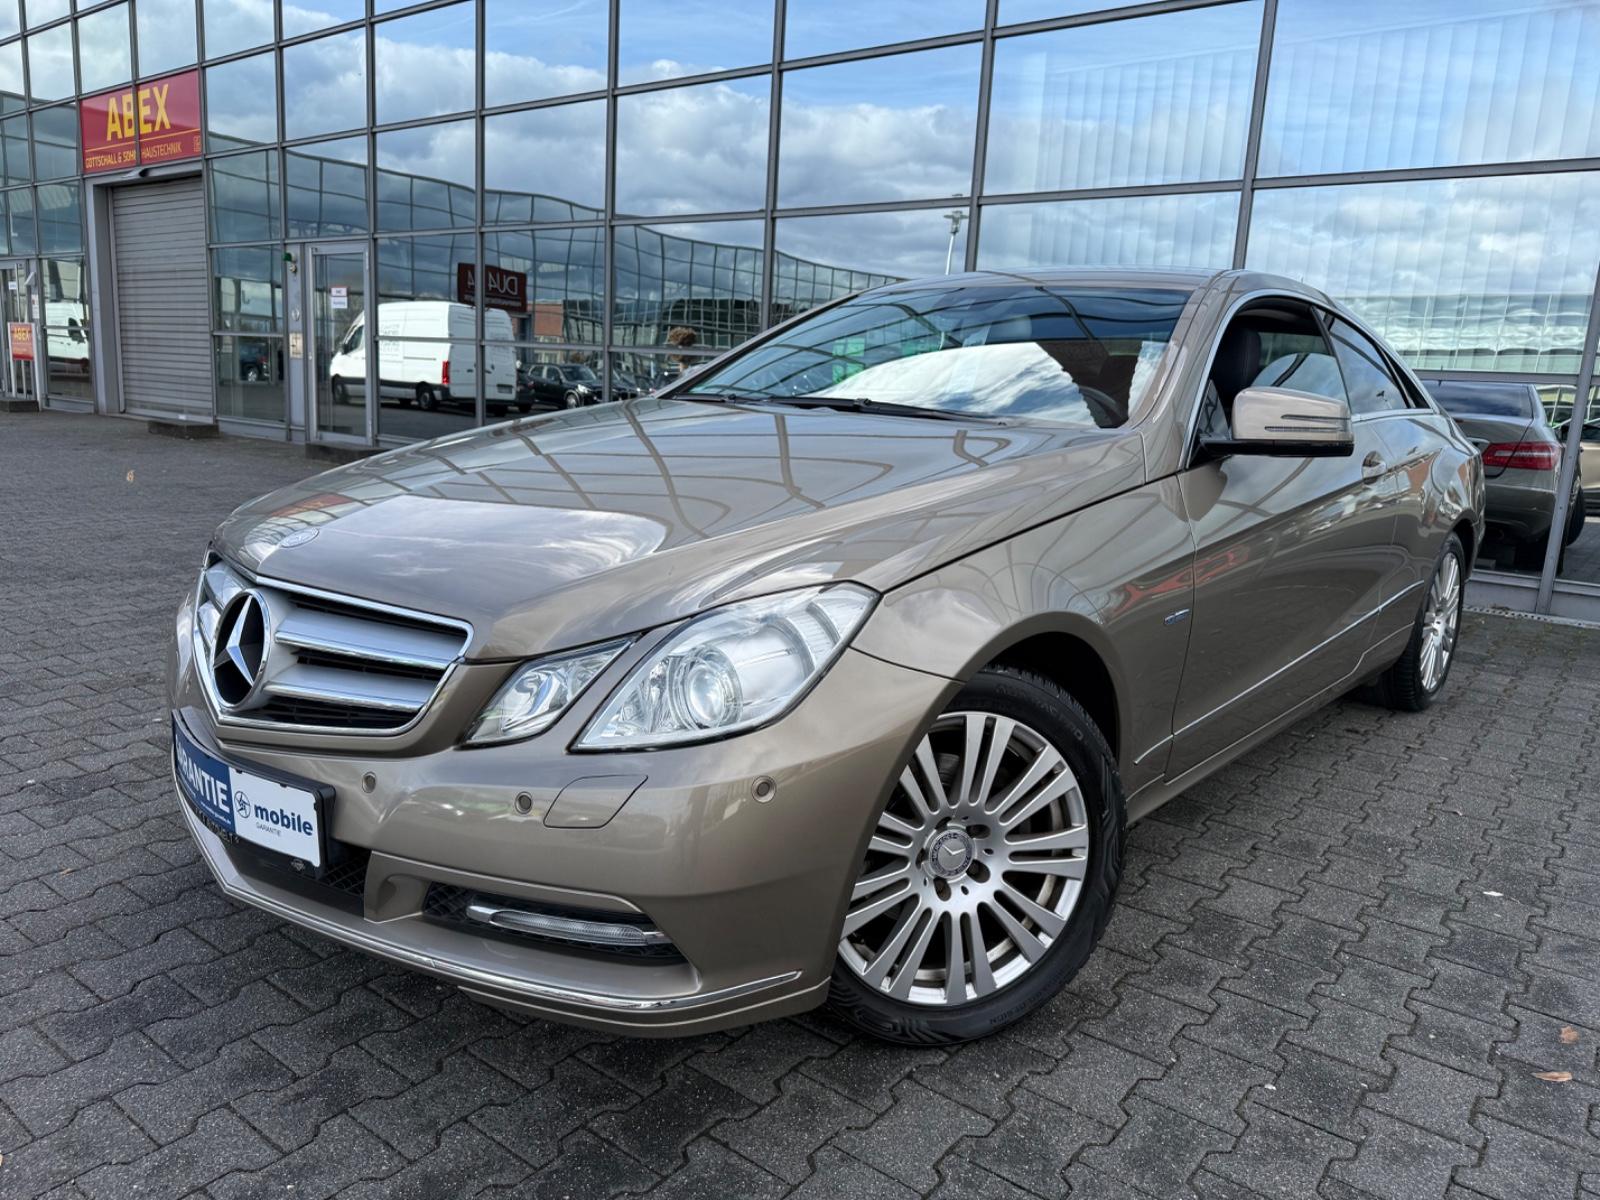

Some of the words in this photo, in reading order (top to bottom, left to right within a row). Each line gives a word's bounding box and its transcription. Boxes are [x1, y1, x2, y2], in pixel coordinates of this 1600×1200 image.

[106, 84, 170, 141] ABEX
[175, 733, 231, 813] ARANTIE
[254, 804, 314, 836] mobile
